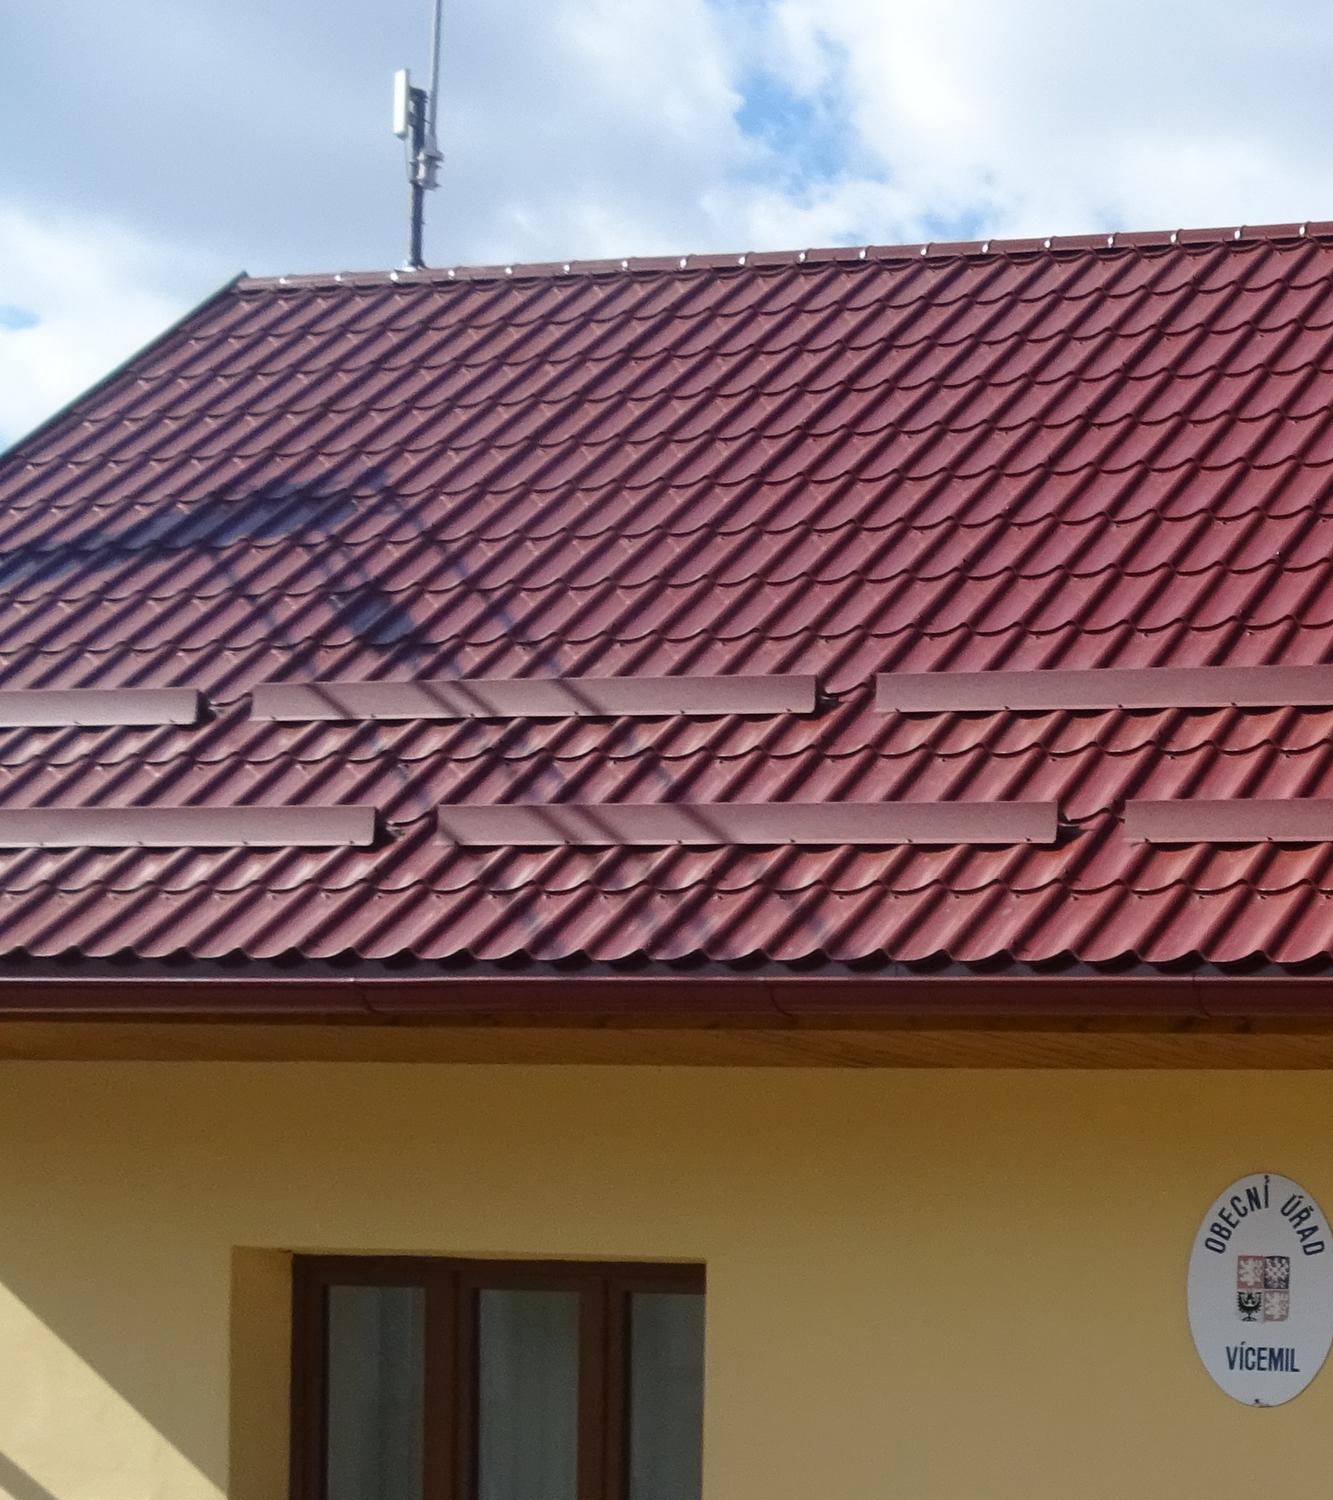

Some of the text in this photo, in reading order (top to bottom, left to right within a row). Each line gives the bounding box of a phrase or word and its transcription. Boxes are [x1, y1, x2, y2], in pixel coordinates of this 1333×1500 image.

[1204, 1179, 1326, 1256] OBECNÍ ÚŘAD
[1225, 1340, 1300, 1373] VÍCEMIL
